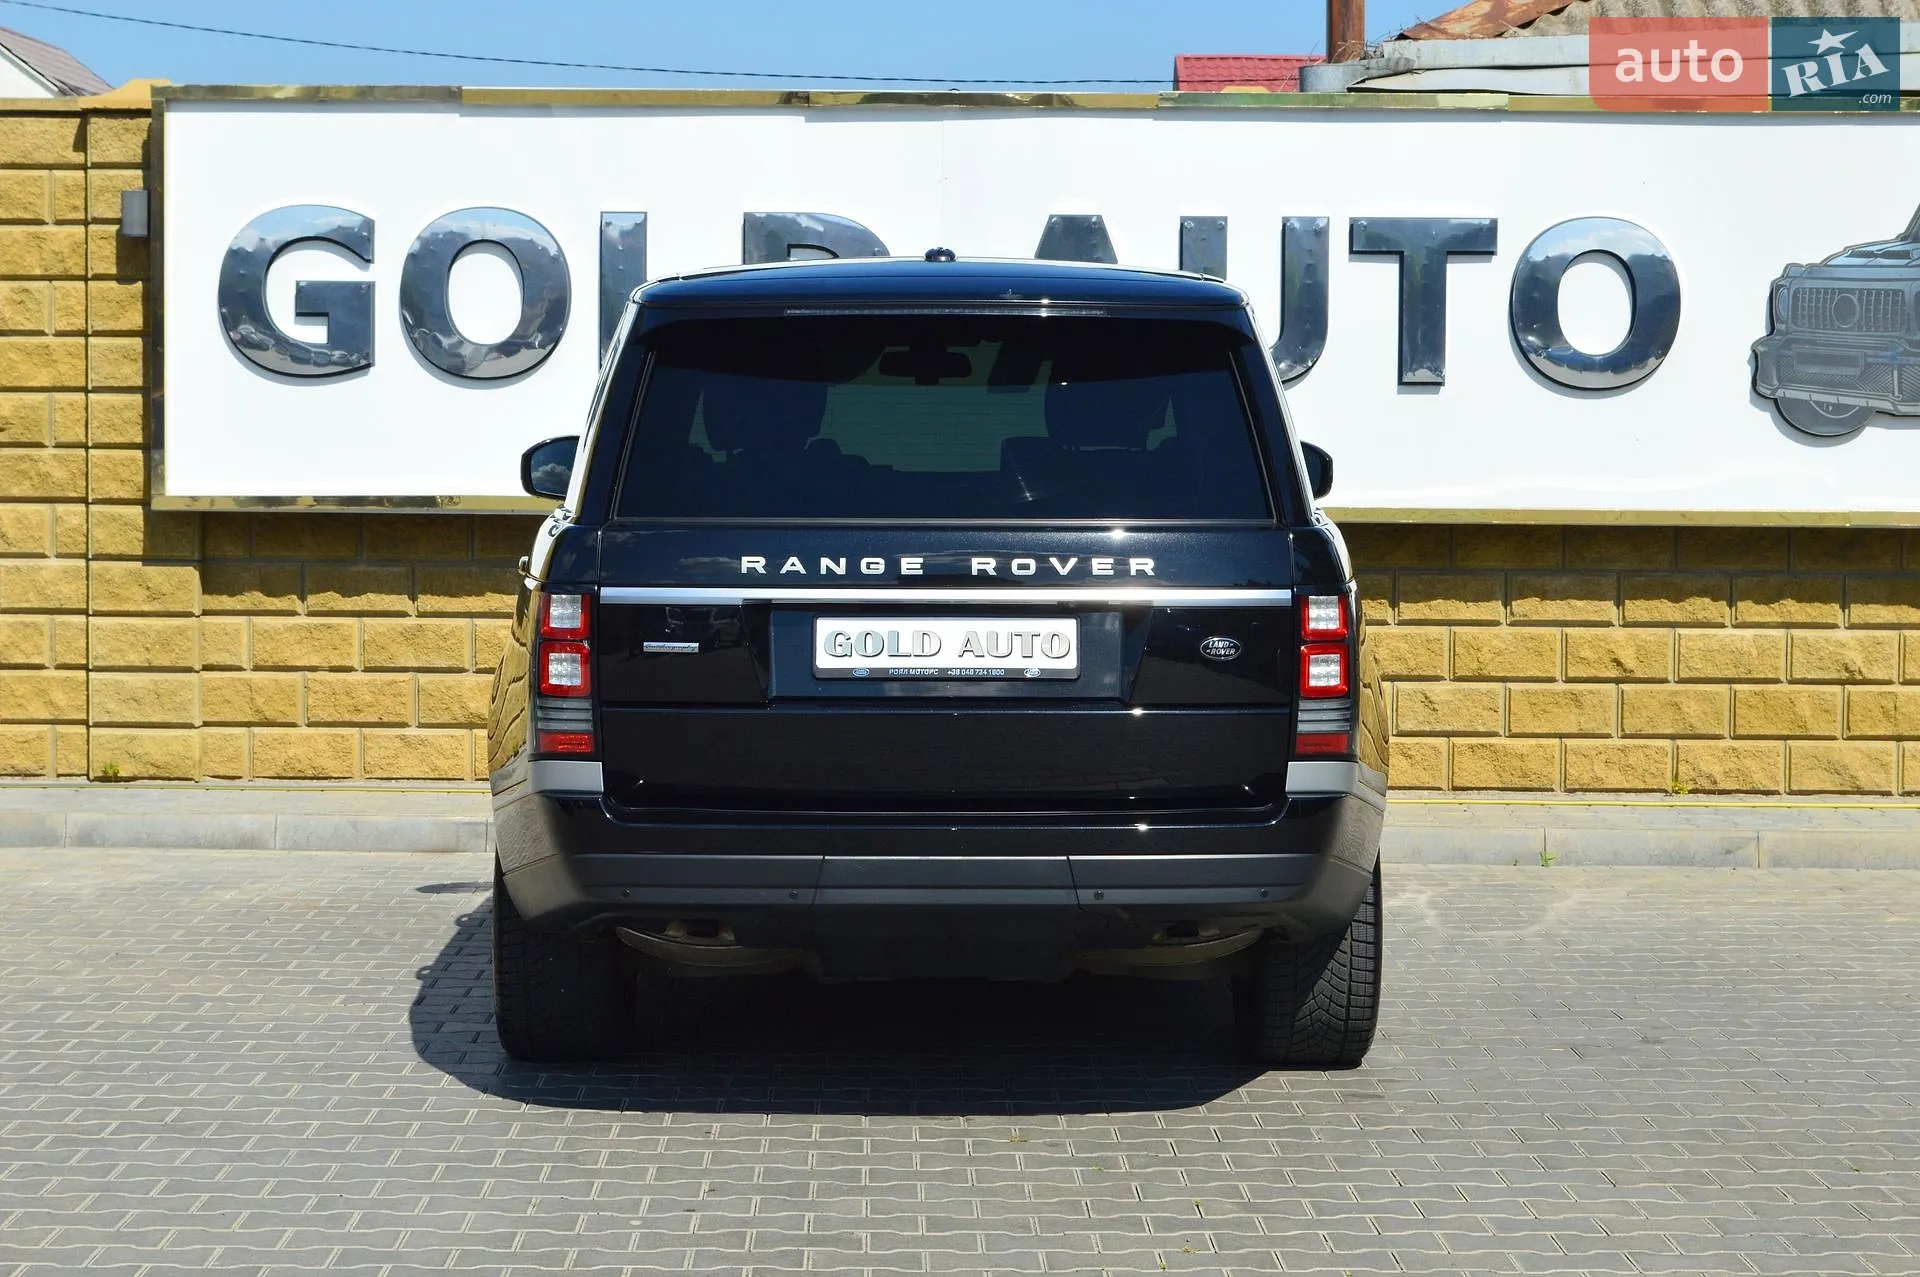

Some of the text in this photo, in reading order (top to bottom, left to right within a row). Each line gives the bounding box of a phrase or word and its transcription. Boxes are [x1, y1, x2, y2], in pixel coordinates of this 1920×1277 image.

[1034, 213, 1682, 391] UTO
[741, 556, 1155, 575] RANGE ROVER
[824, 630, 1070, 658] GOLD AUTO
[909, 668, 939, 676] МОТОРС
